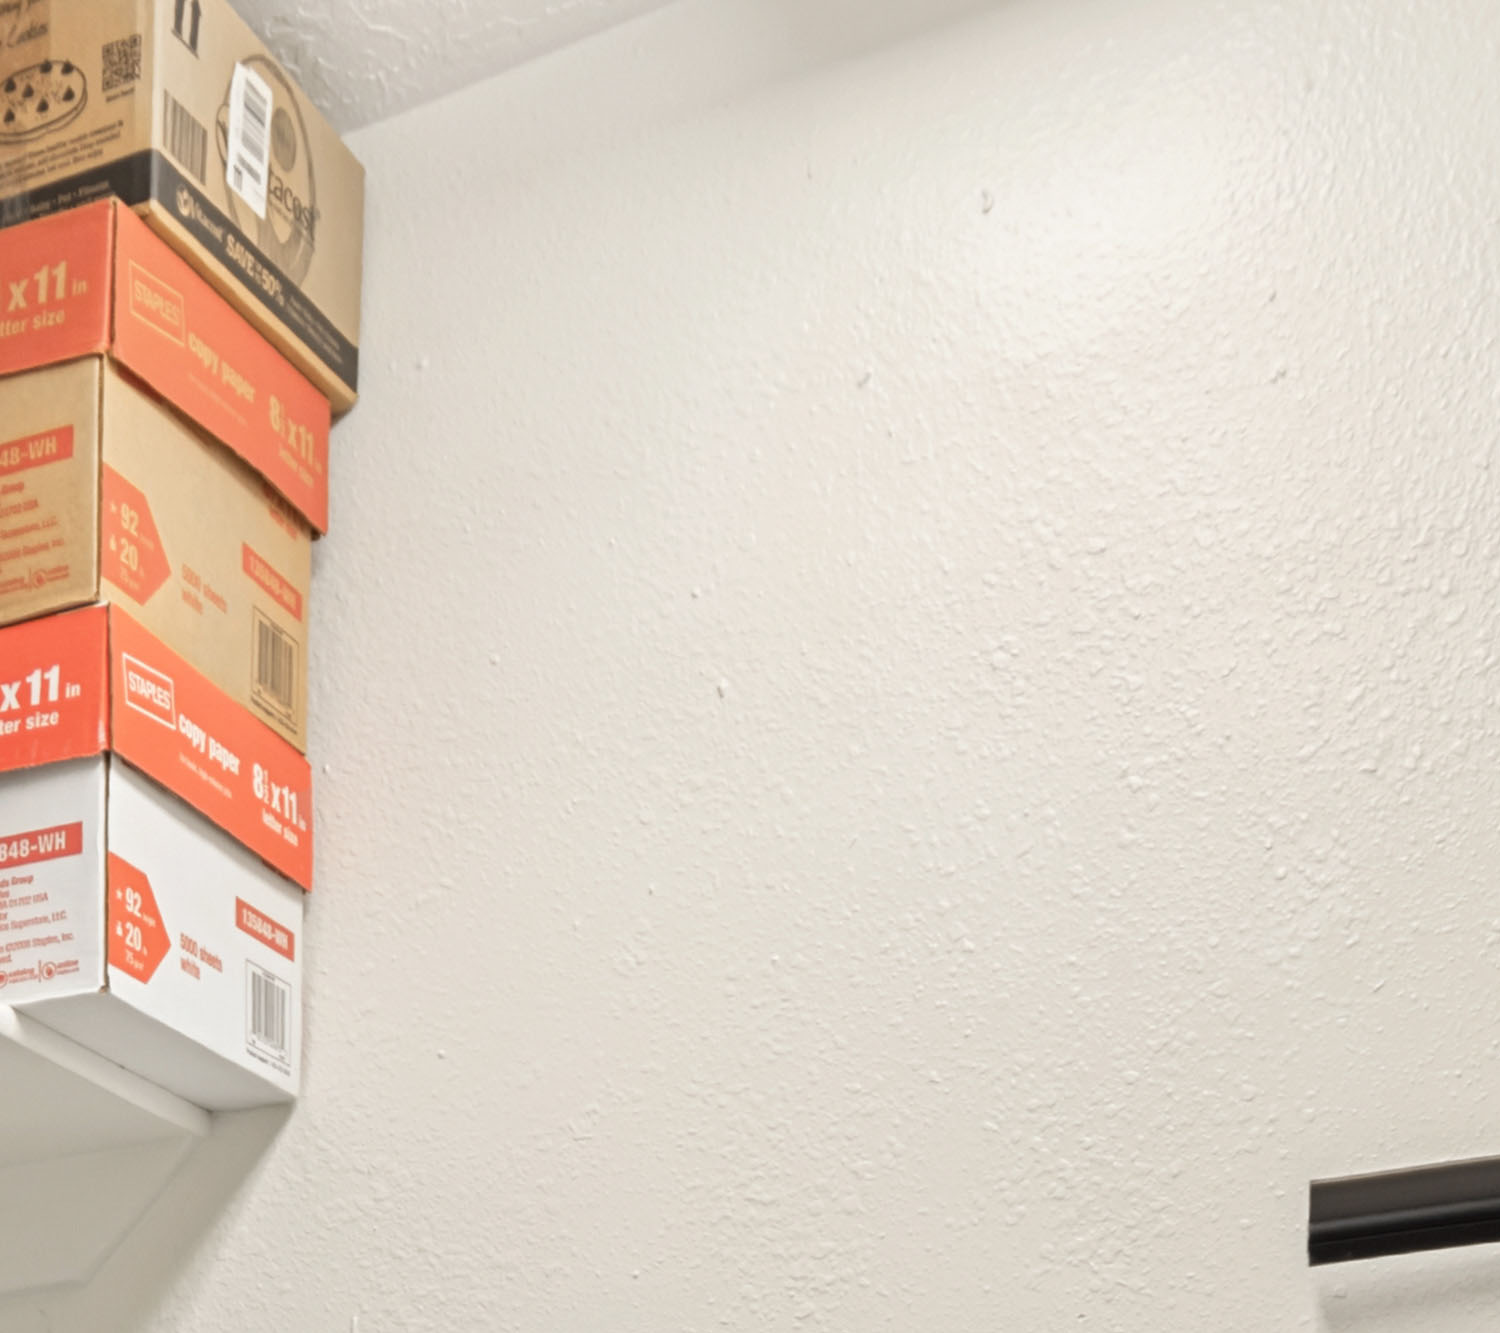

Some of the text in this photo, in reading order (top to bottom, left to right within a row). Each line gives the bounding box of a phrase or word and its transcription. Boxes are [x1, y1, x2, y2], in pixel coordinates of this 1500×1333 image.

[33, 261, 67, 301] 11
[32, 308, 66, 331] size
[119, 502, 140, 537] 92
[119, 536, 139, 572] 20
[0, 680, 21, 713] x
[25, 664, 60, 706] 11
[65, 681, 81, 699] in
[128, 670, 172, 711] STAPLES
[25, 710, 60, 730] size
[179, 713, 206, 754] copy
[209, 736, 241, 776] paper
[281, 785, 297, 826] 11
[125, 886, 142, 919] 92
[125, 920, 142, 952] 20
